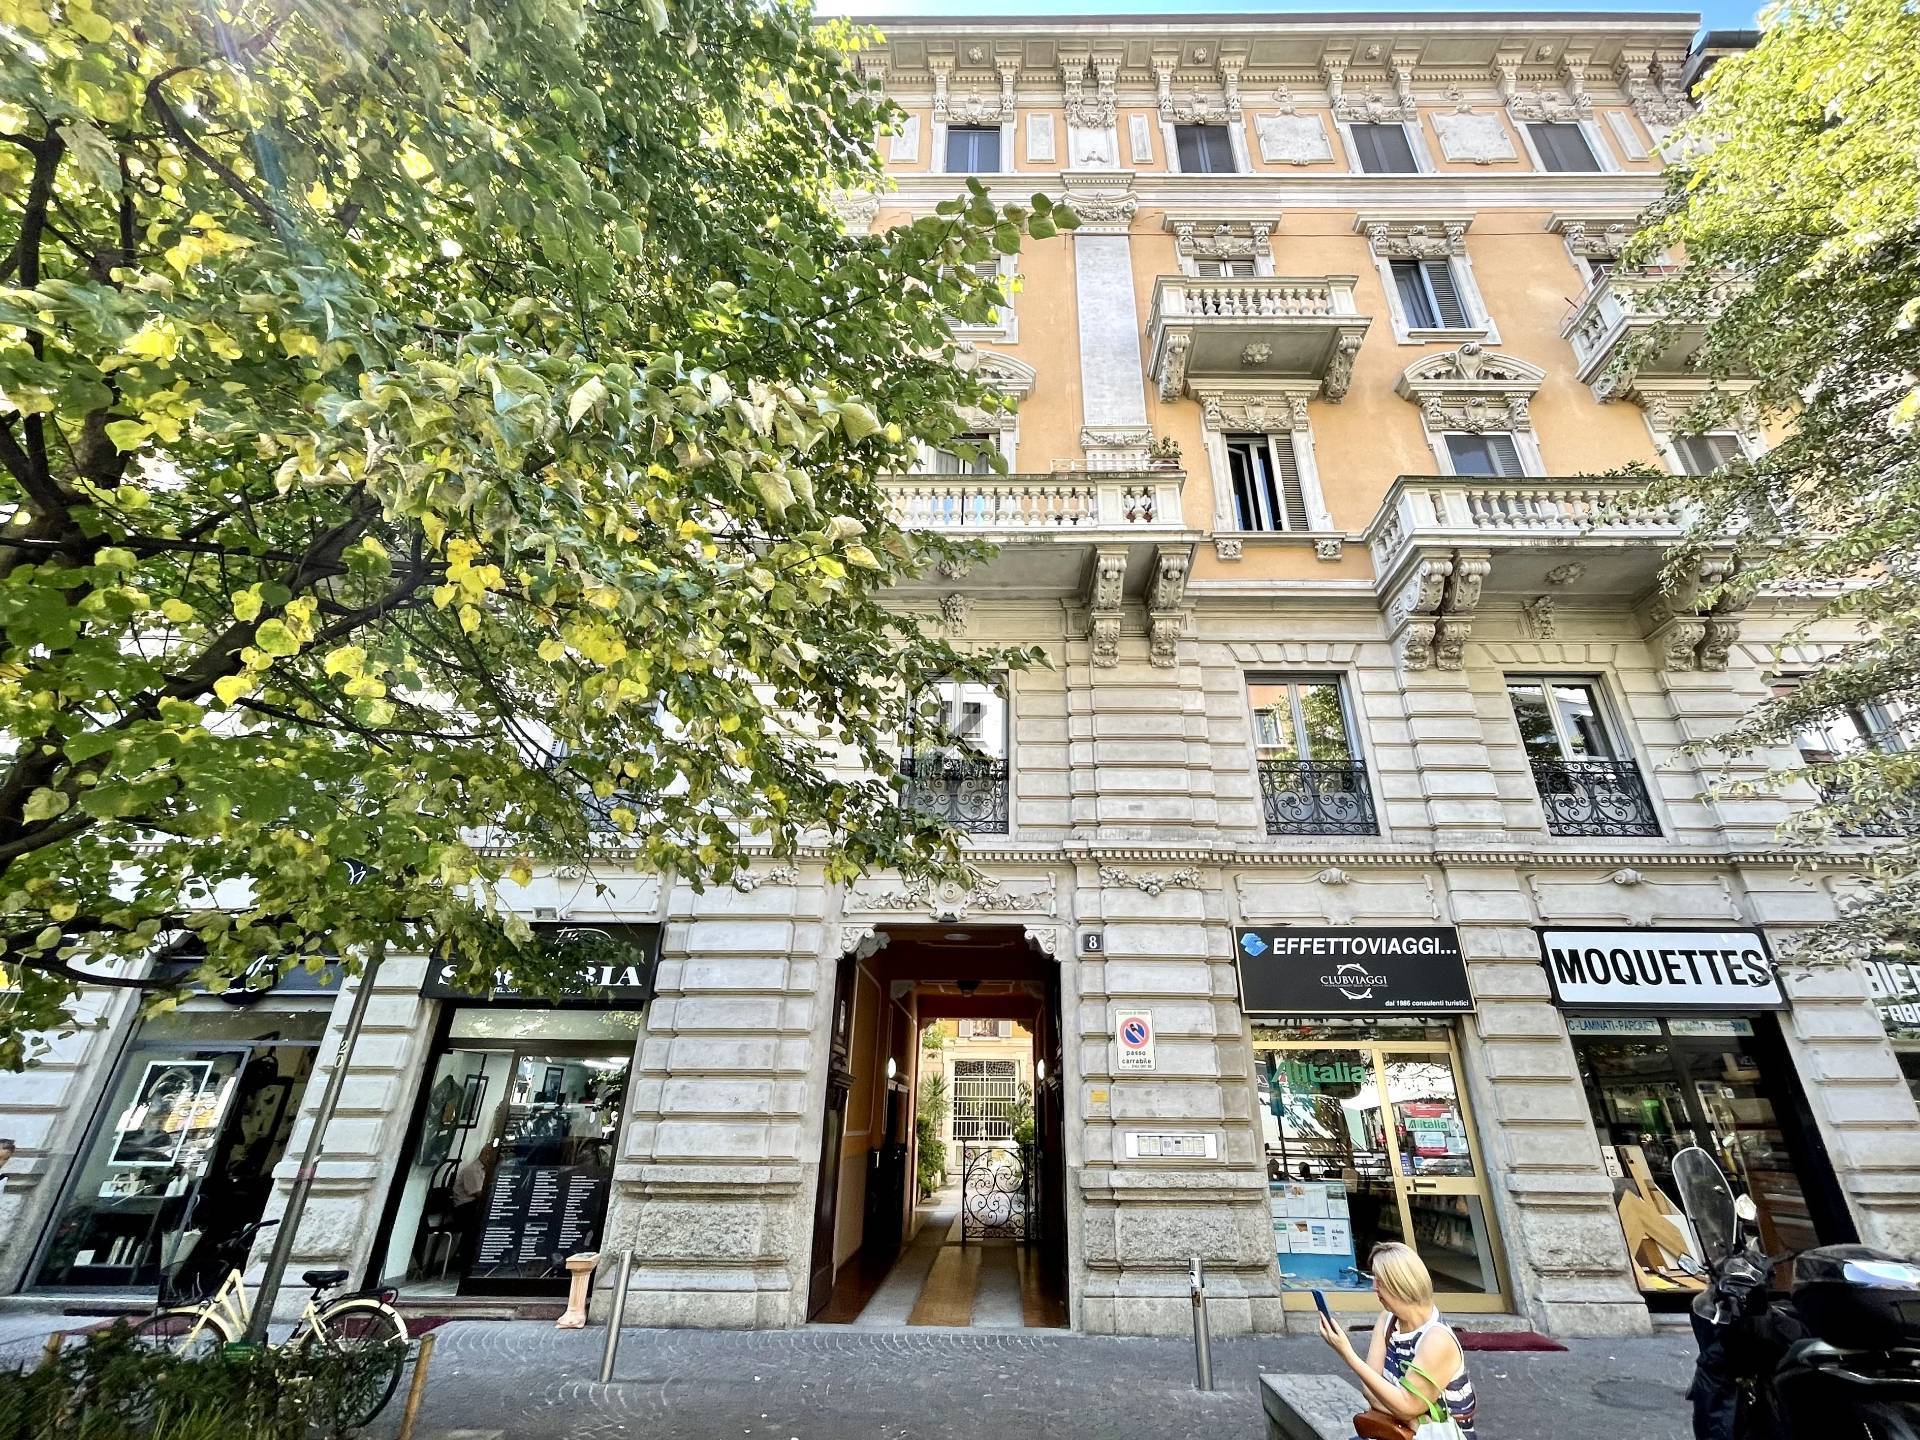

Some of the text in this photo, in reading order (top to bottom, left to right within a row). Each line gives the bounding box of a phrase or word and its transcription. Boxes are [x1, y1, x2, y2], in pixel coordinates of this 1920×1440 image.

[1088, 935, 1098, 949] 8
[1551, 947, 1772, 988] MOQUETTES
[1320, 975, 1388, 986] CLUBVIAGGI
[1411, 999, 1444, 1007] consulenti
[1445, 999, 1469, 1007] turistici
[1271, 1059, 1367, 1084] Alitalia
[1408, 1119, 1448, 1129] Alitalia
